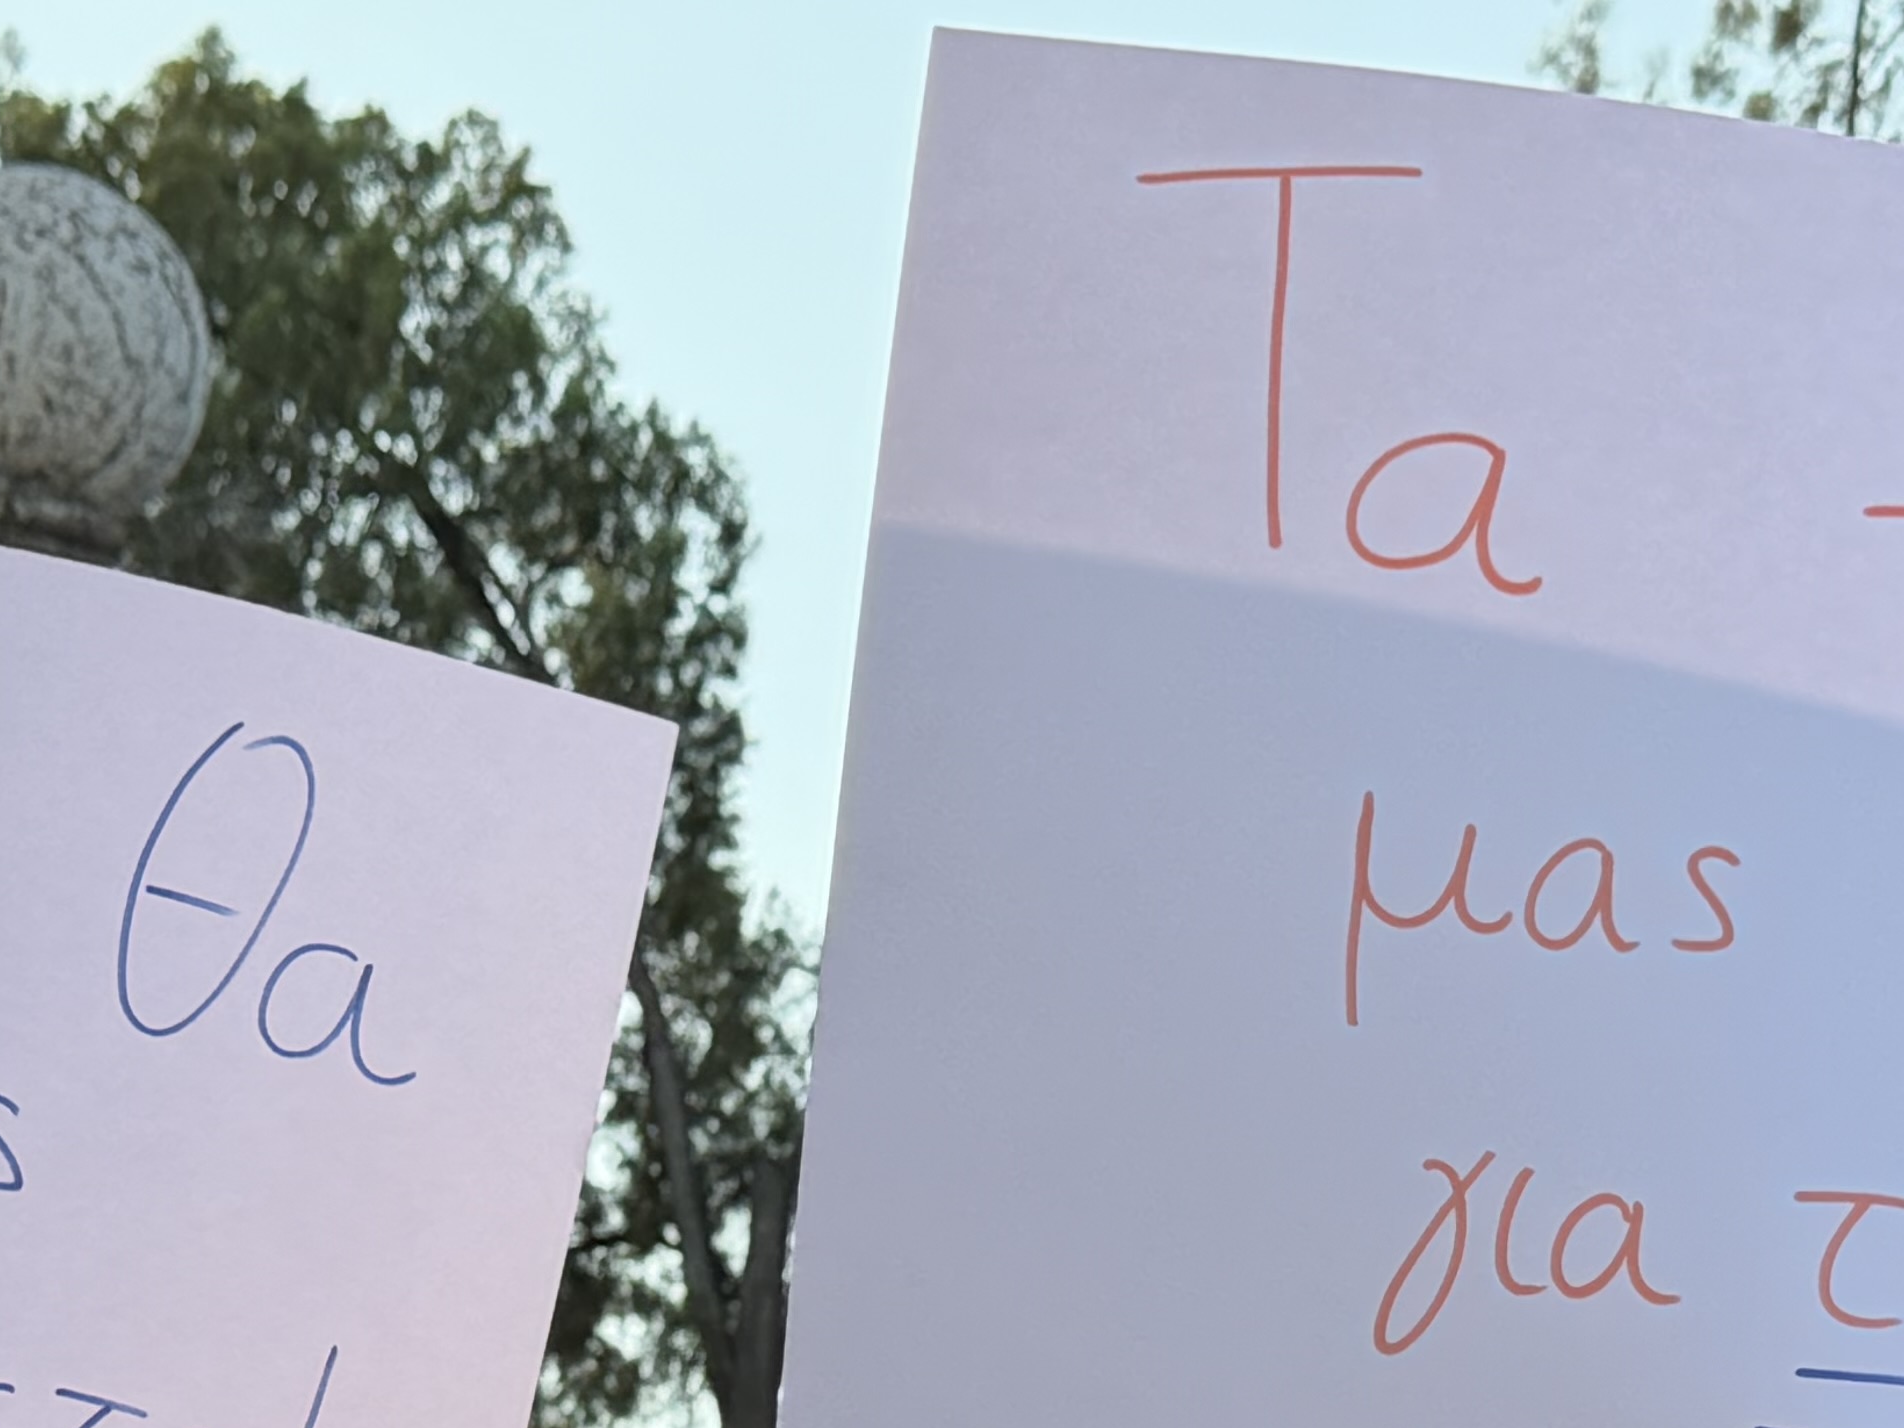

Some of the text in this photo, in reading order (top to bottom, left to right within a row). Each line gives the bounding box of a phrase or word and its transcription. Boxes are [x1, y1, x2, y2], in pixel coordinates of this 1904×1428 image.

[1139, 166, 1543, 597] Τα
[117, 721, 417, 1087] θα
[1344, 791, 1741, 1028] μας
[1373, 1151, 1682, 1357] για
